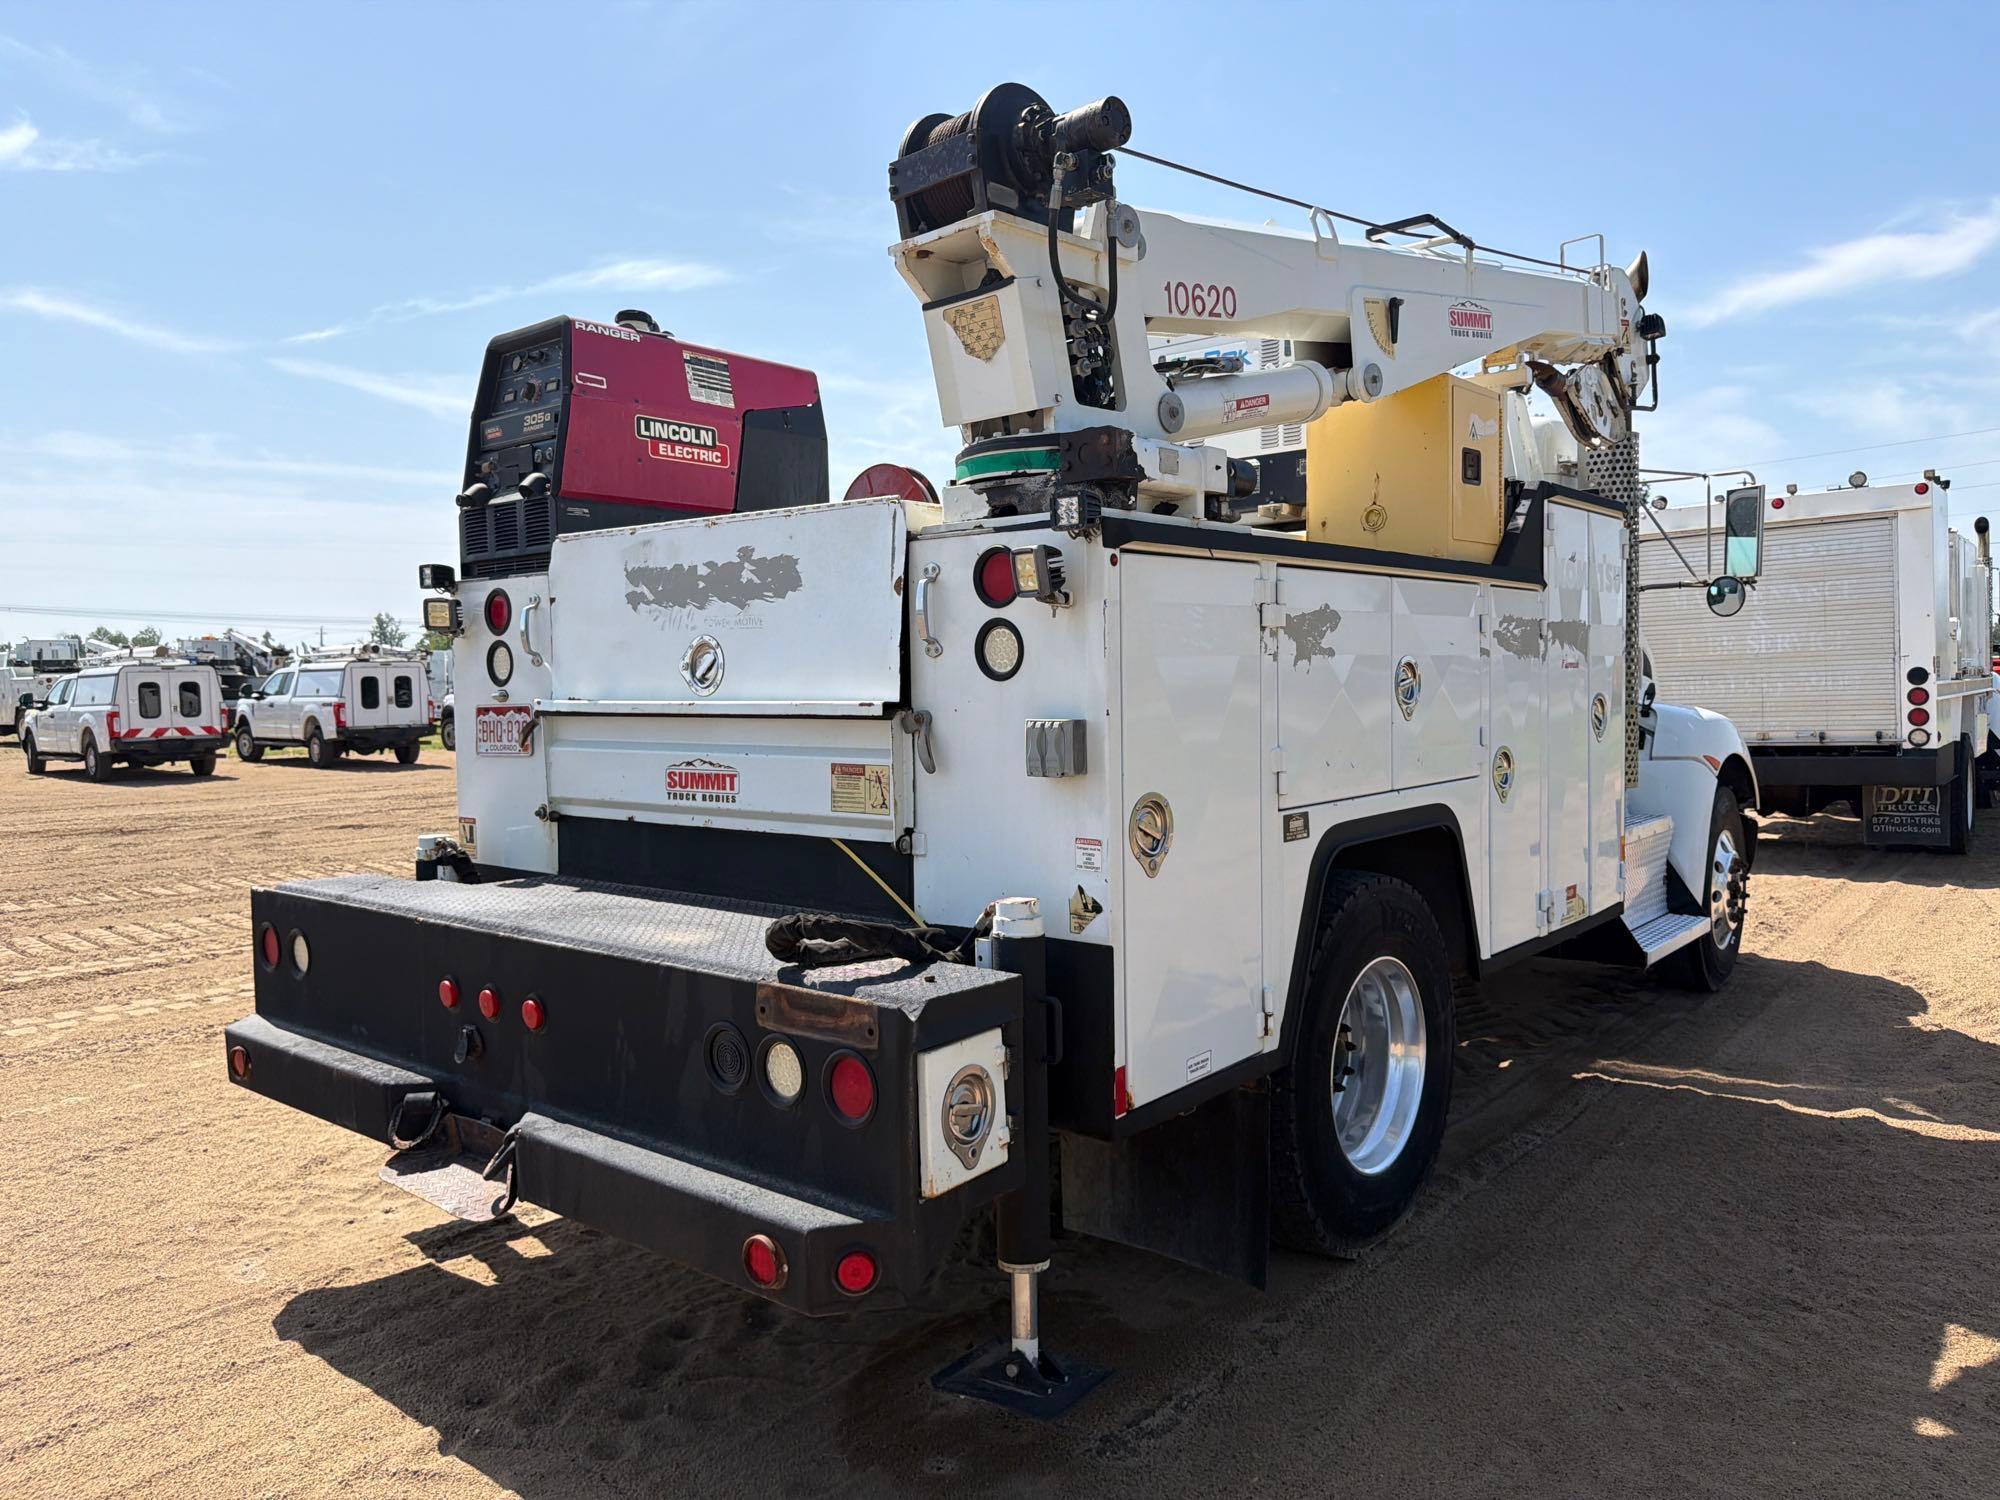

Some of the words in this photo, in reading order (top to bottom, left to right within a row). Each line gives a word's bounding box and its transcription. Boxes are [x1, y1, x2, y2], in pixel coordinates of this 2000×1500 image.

[1164, 281, 1237, 319] 10620
[1450, 310, 1491, 330] SUMMIT
[575, 321, 641, 343] RANGER
[1450, 330, 1470, 338] TRUCK
[640, 419, 714, 447] LINCOLN
[658, 443, 722, 464] ELECTRIC
[667, 770, 738, 792] SUMMIT
[666, 791, 697, 802] TRUCK
[701, 793, 737, 803] BODIES
[1878, 786, 1934, 804] DTI
[1878, 804, 1936, 812] TRUCKS
